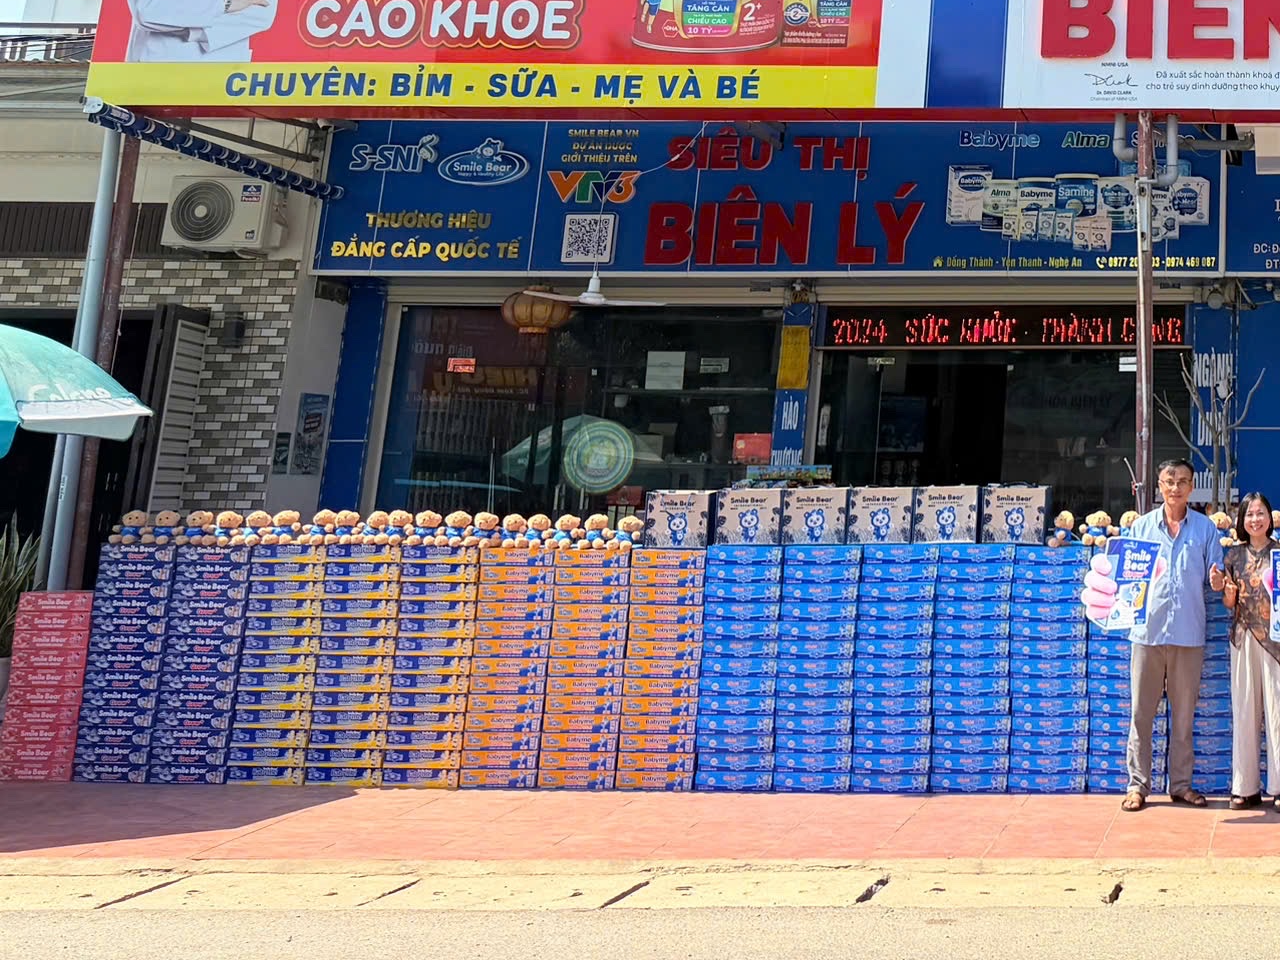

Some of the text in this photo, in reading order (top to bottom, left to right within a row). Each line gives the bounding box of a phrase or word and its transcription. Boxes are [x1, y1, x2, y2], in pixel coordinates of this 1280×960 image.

[225, 64, 761, 106] CHUYÊN: BỈM SỮA MẸ VÀ BÉ
[959, 130, 1111, 151] Babyme Alma
[666, 126, 871, 181] SIÊU THỊ
[453, 161, 512, 172] Smile Bear
[547, 170, 642, 203] VTV3
[990, 188, 1011, 197] Alma
[1020, 190, 1054, 199] Babyme
[1058, 187, 1095, 197] Samine
[366, 209, 492, 232] THƯƠNG HIỆU
[643, 181, 925, 266] BIÊN LÝ
[331, 233, 523, 262] ĐẲNG CẤP QUỐC TẾ
[833, 318, 888, 344] 2024
[120, 545, 157, 553] Smile Bear
[1124, 549, 1152, 562] Smile
[1123, 560, 1151, 571] Bear
